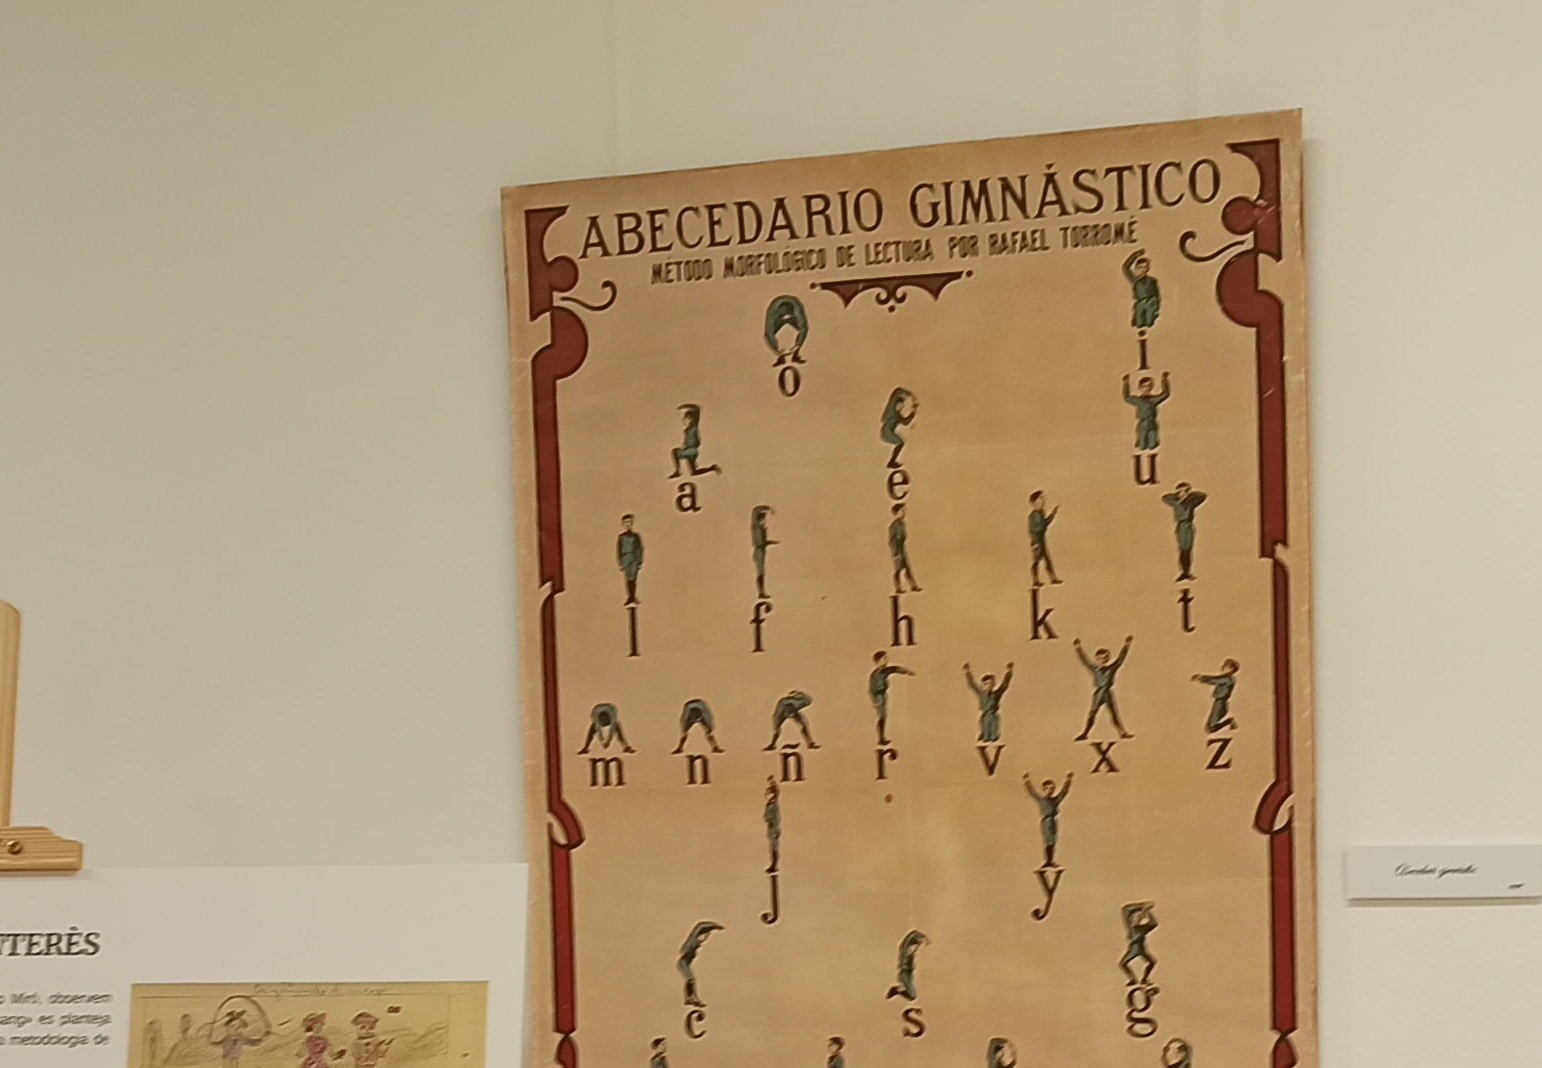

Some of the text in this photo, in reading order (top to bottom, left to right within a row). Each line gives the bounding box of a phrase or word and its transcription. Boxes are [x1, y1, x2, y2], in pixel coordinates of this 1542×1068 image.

[578, 158, 1223, 260] ABECEDARIO GIMNÁSTICO
[835, 244, 856, 268] DE
[864, 239, 934, 265] LECTURA
[948, 235, 979, 259] POR
[988, 229, 1050, 255] RAFAEL
[1136, 331, 1151, 370] i
[777, 366, 800, 397] o
[887, 469, 910, 501] e
[1132, 452, 1159, 486] u
[675, 482, 701, 512] a
[750, 602, 773, 652] f
[890, 596, 917, 648] h
[1029, 589, 1058, 641] k
[1178, 589, 1196, 633] t
[589, 755, 625, 788] m
[686, 754, 711, 785] n
[780, 744, 805, 782] ñ
[875, 748, 898, 780] r
[977, 744, 1005, 778] v
[1090, 741, 1120, 774] x
[1205, 738, 1232, 771] z
[760, 874, 779, 925] j
[1031, 868, 1065, 921] y
[684, 1009, 707, 1039] c
[901, 1006, 927, 1038] s
[1125, 984, 1159, 1039] g
